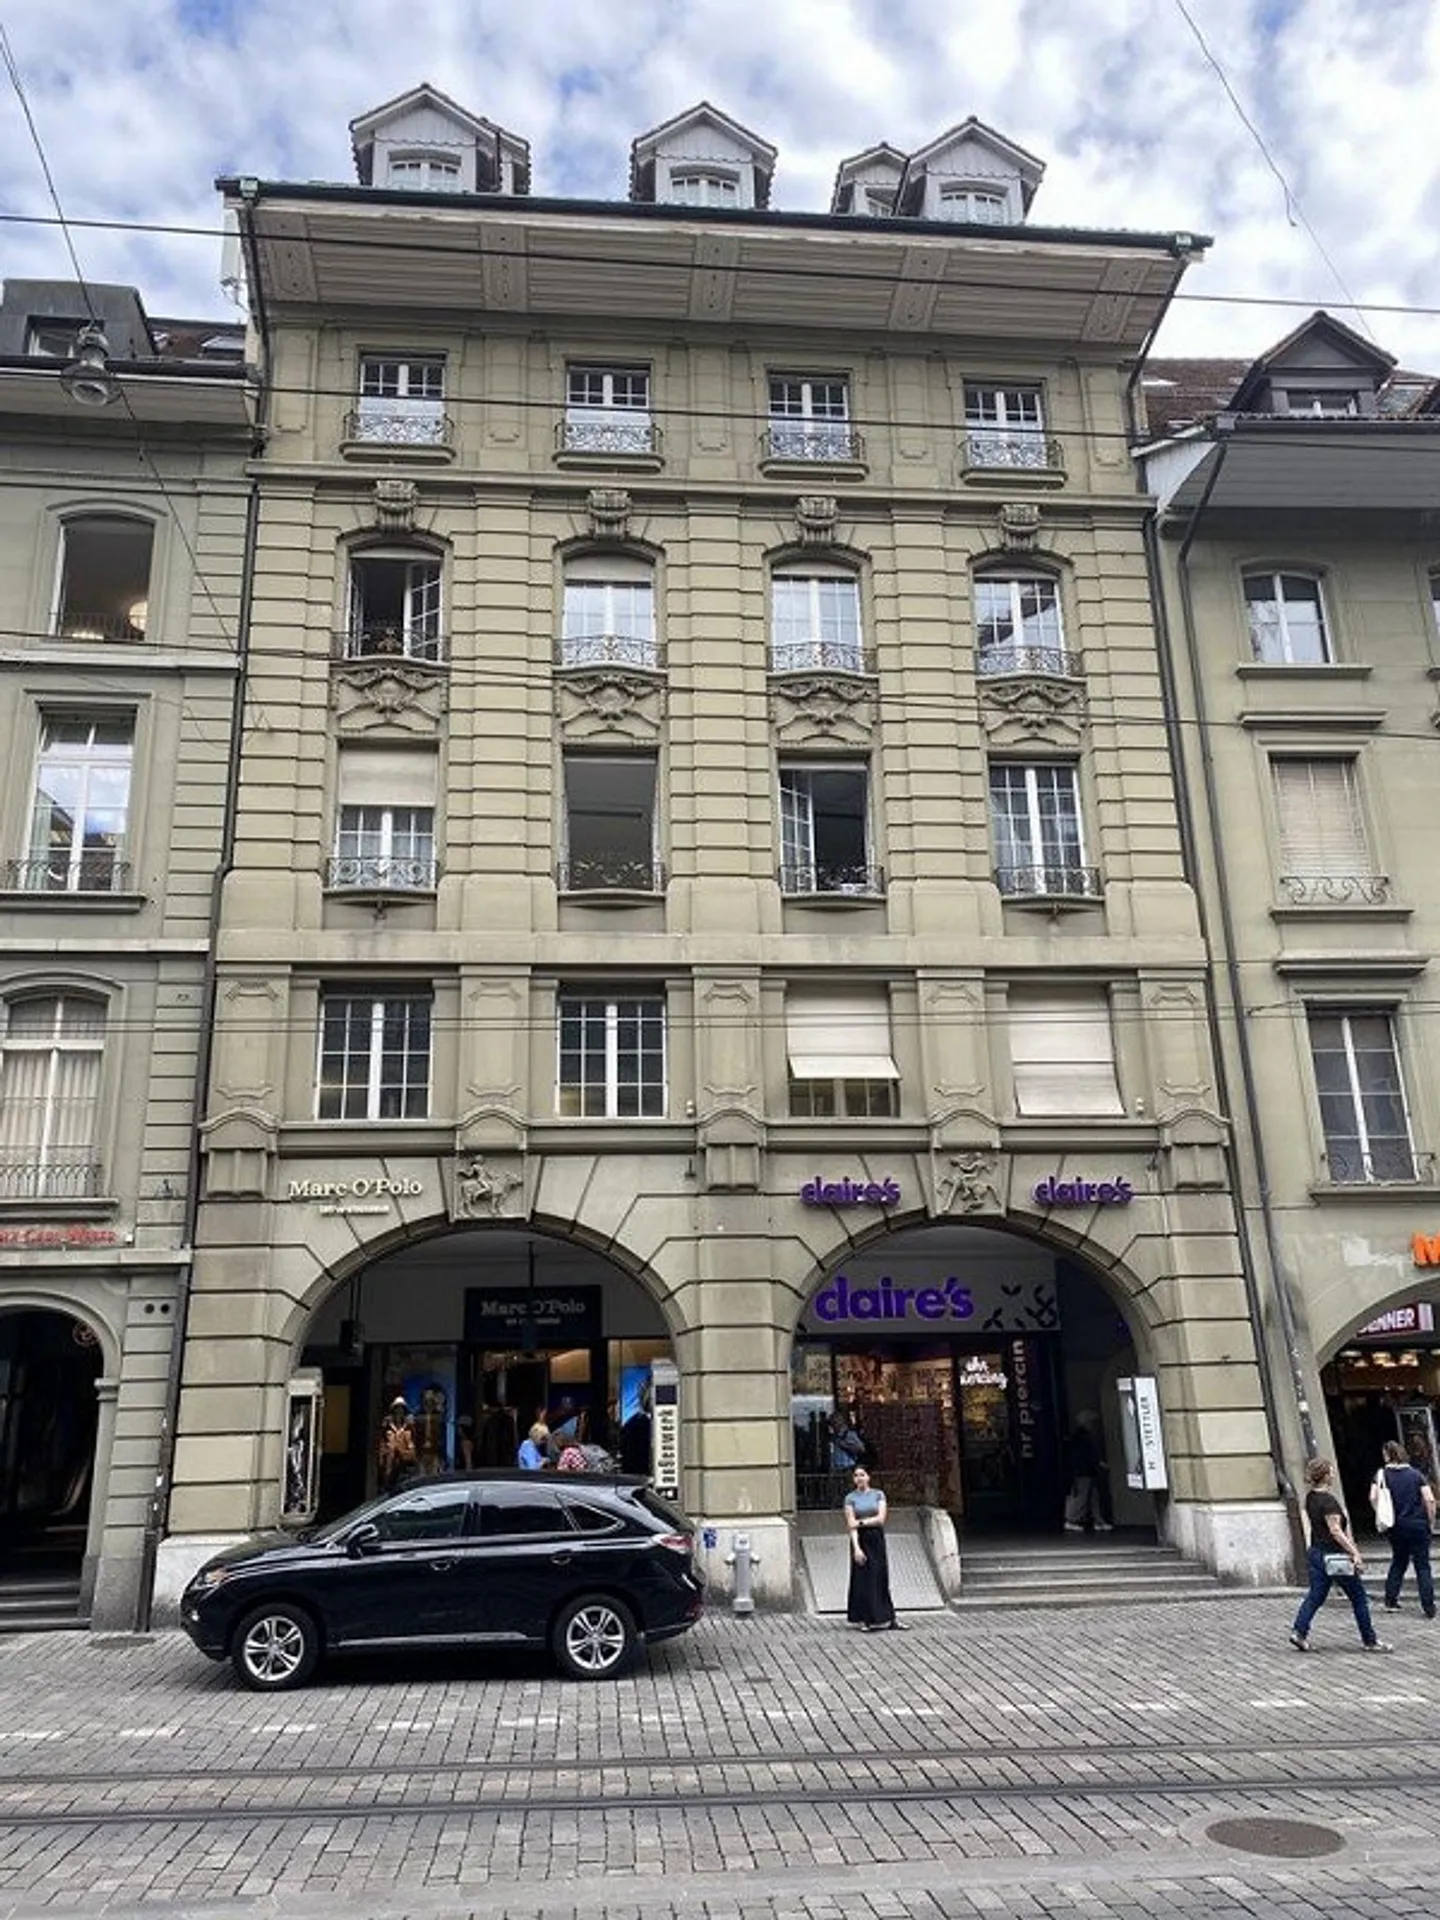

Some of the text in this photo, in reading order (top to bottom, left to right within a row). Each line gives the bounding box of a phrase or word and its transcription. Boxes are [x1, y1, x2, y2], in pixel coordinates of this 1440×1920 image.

[288, 1177, 423, 1197] Marc O'Polo
[800, 1177, 901, 1206] claire's
[1034, 1177, 1134, 1207] claire's
[480, 1300, 528, 1316] Marc
[815, 1277, 975, 1322] claire's
